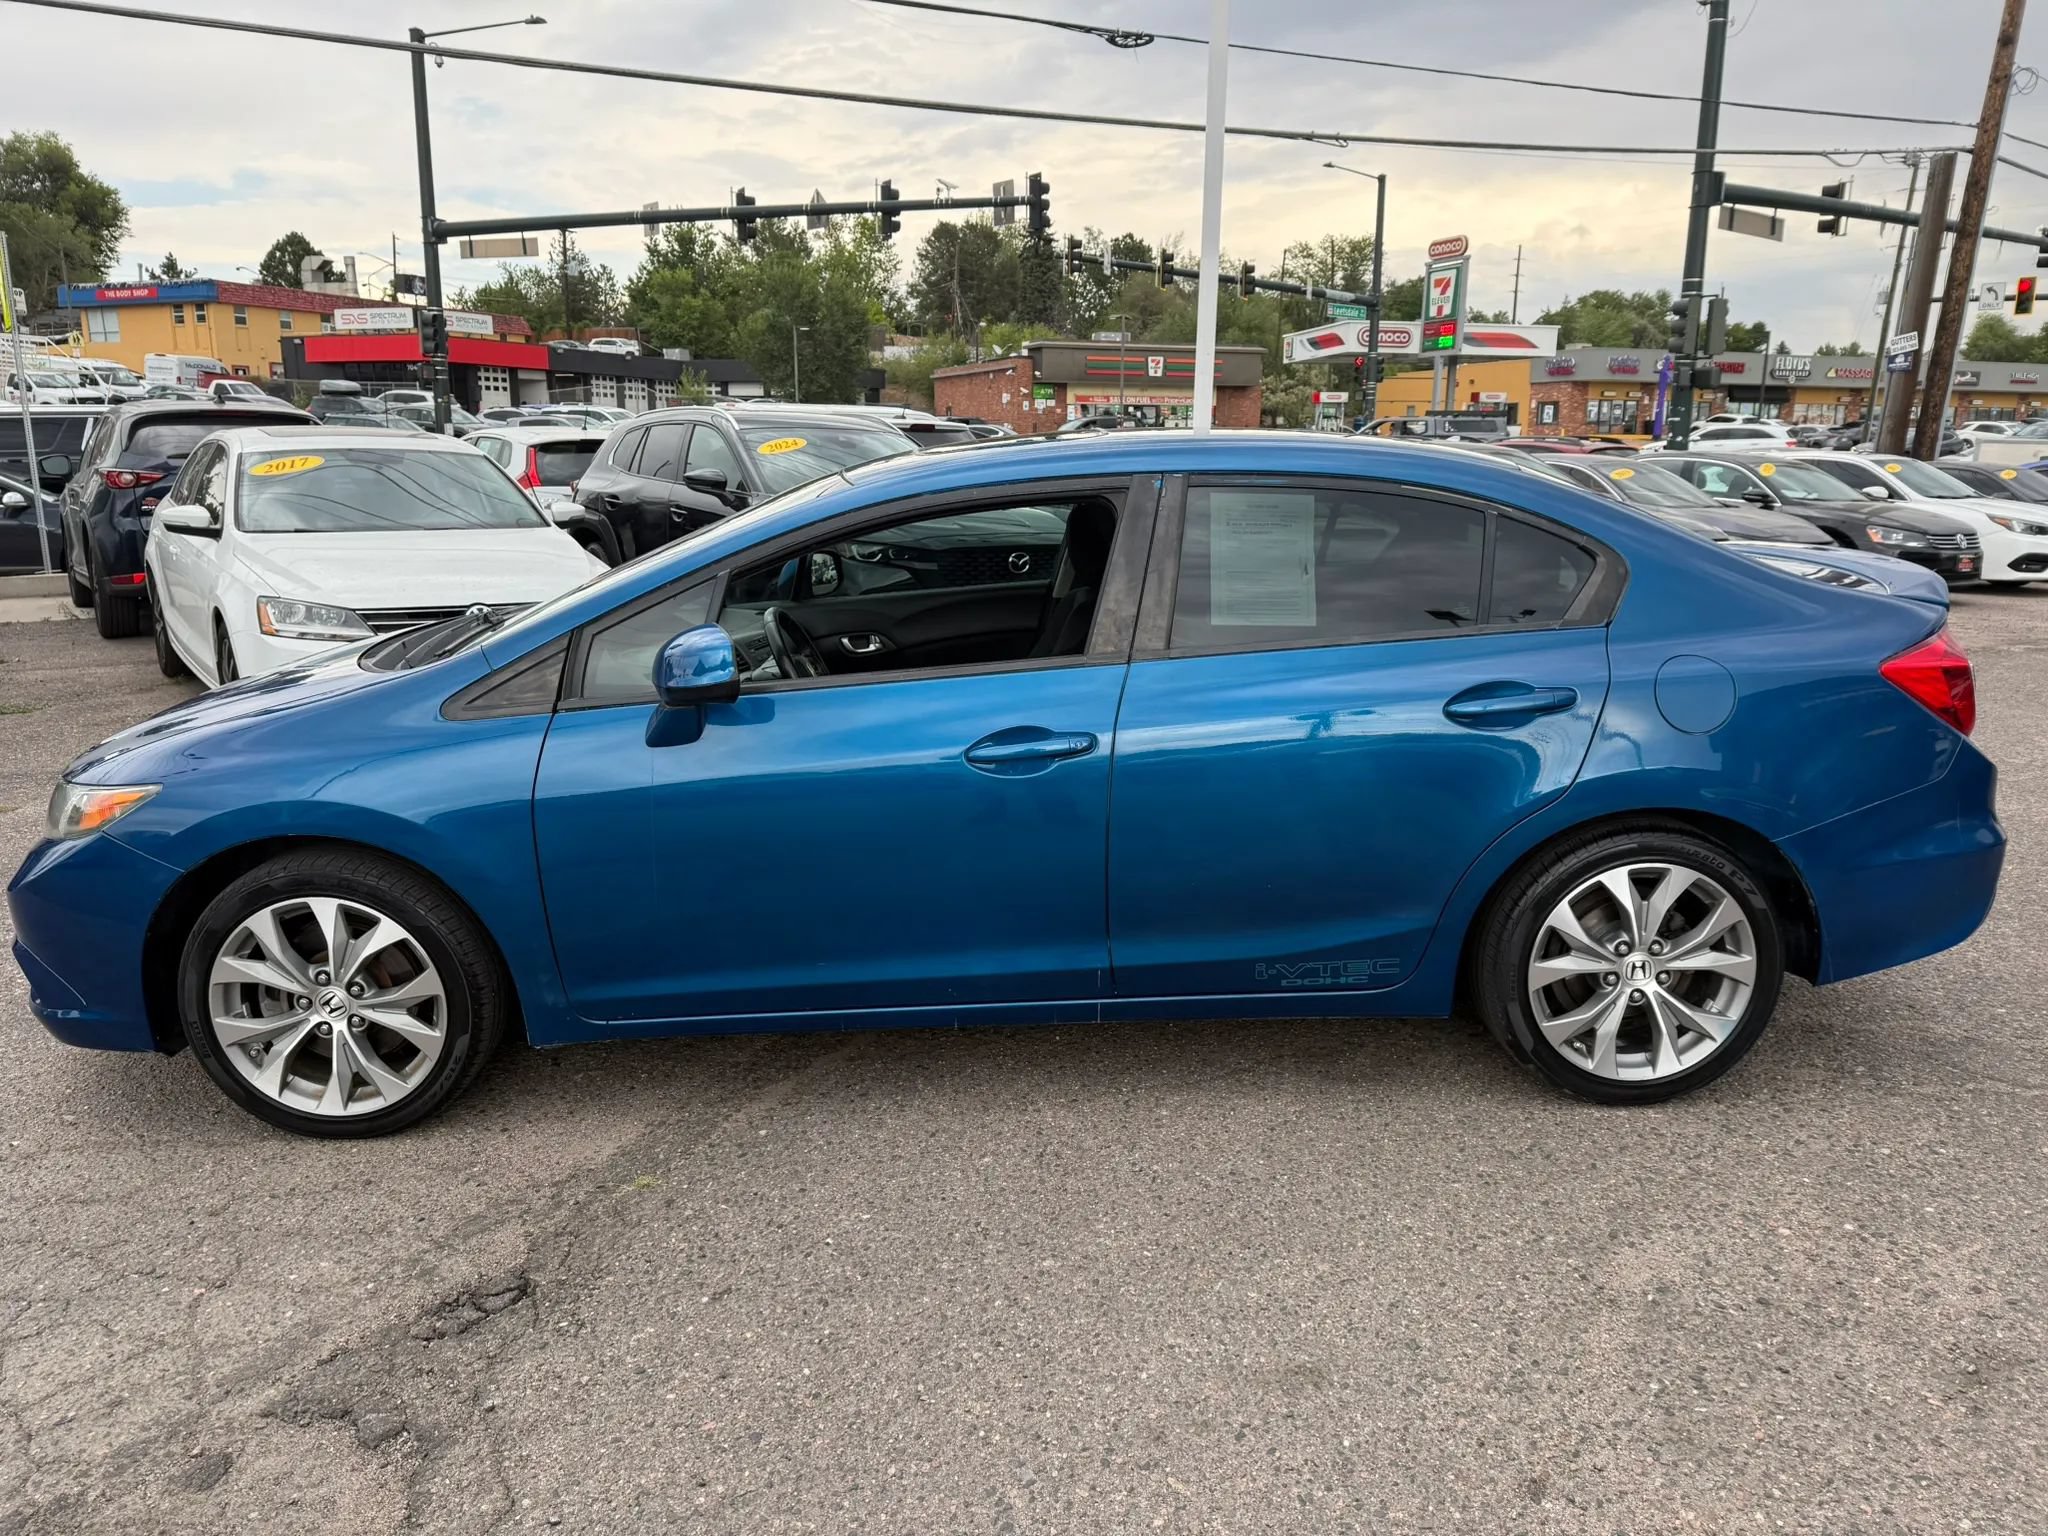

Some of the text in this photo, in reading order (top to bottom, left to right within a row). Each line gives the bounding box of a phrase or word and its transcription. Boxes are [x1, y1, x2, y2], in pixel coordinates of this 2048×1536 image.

[132, 289, 149, 297] SHOP
[369, 312, 407, 320] SPECTRUM
[455, 316, 488, 326] SPECTRUM
[1890, 334, 1917, 347] GUTTERS
[1837, 367, 1874, 378] MASSAG
[1126, 396, 1136, 404] ON
[1136, 396, 1151, 404] FUEL
[766, 439, 799, 453] 2024
[263, 457, 310, 474] 2017
[1255, 958, 1400, 980] i-VTEC
[1281, 975, 1369, 987] DOHC
